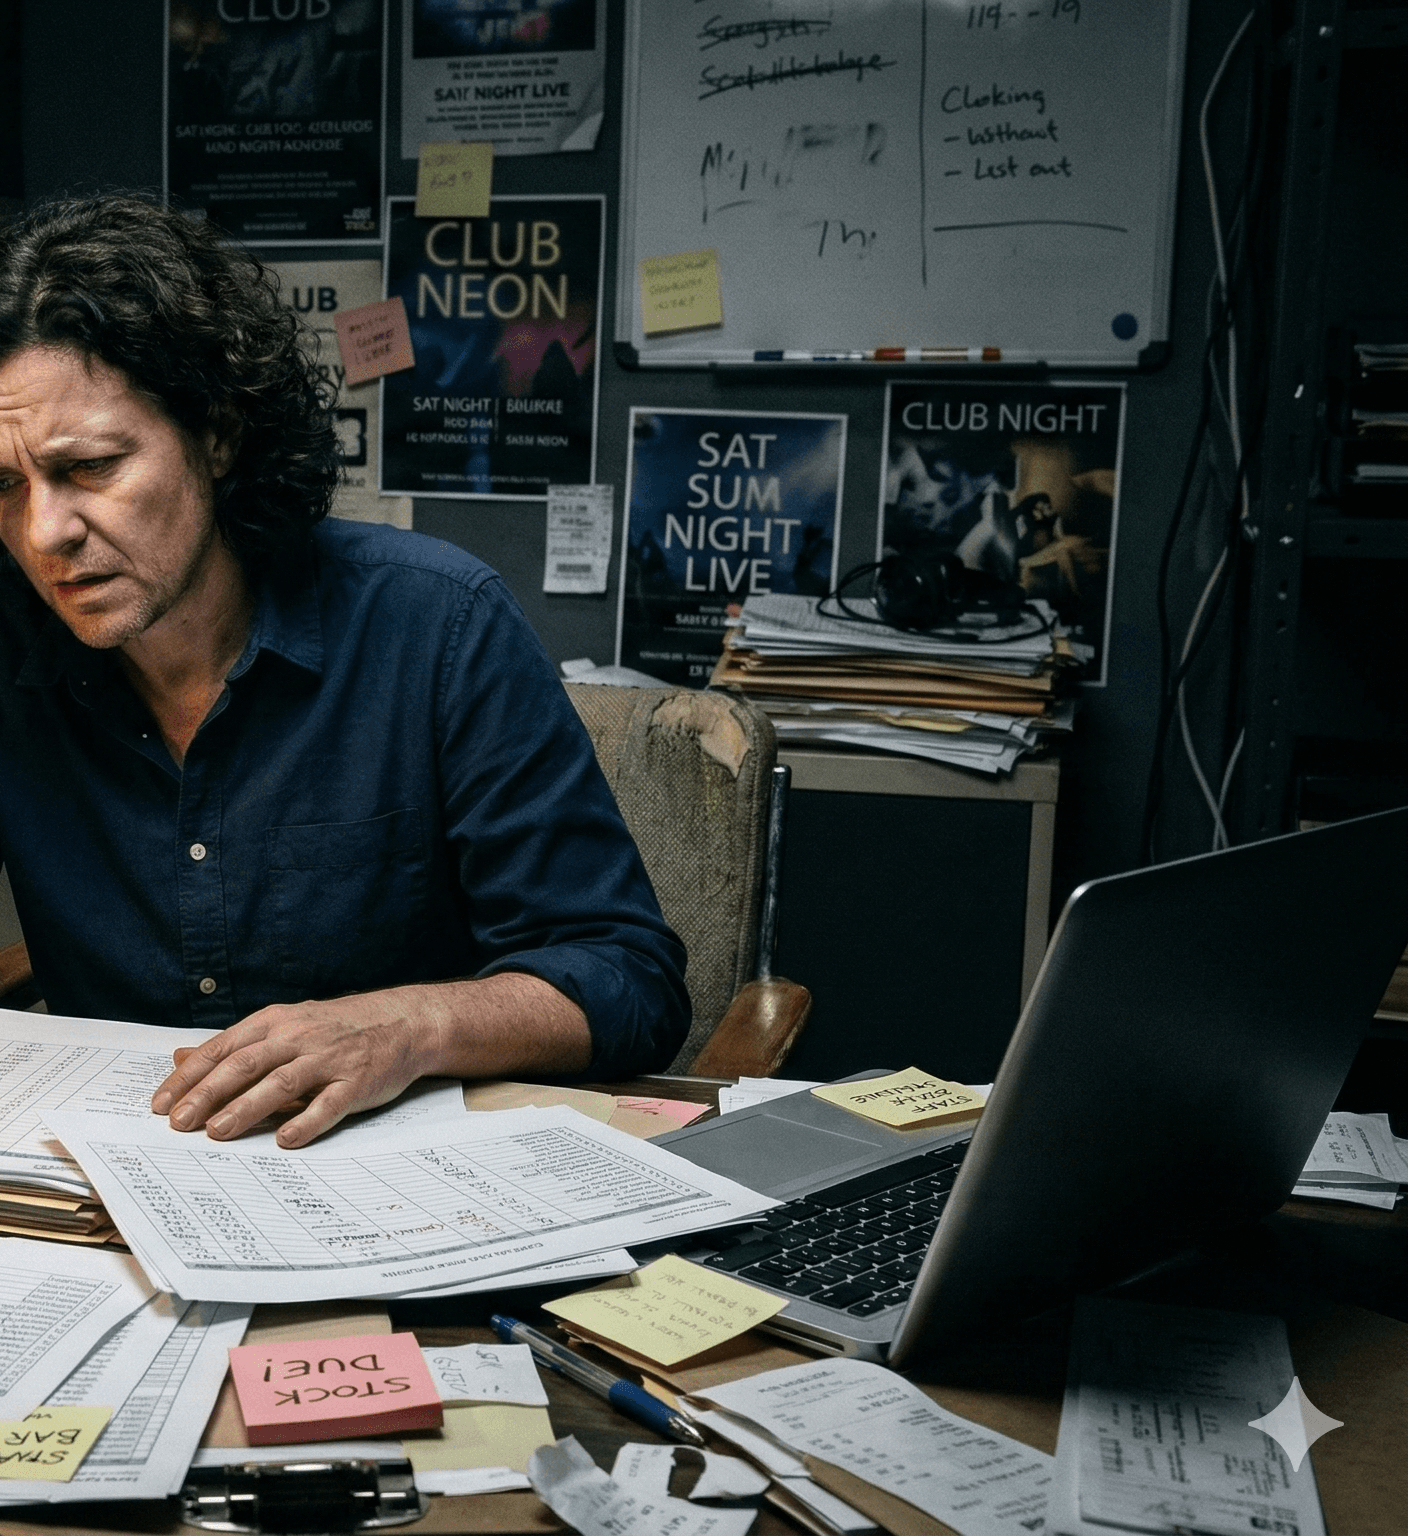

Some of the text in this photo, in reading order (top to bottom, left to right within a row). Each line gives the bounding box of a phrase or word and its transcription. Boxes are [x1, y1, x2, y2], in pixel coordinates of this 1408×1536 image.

[217, 0, 332, 23] CLUB
[474, 84, 529, 100] NIGHT
[532, 82, 570, 98] LIVE
[425, 221, 562, 268] CLUB
[417, 273, 568, 319] NEON
[412, 396, 440, 413] SAT
[443, 396, 492, 414] NIGHT
[901, 402, 1108, 433] CLUB NIGHT
[697, 432, 778, 469] SAT
[687, 473, 782, 511] SUM
[664, 514, 801, 555] NIGHT
[684, 558, 772, 594] LIVE
[263, 1353, 386, 1382] DUE!
[274, 1376, 412, 1408] STOCK
